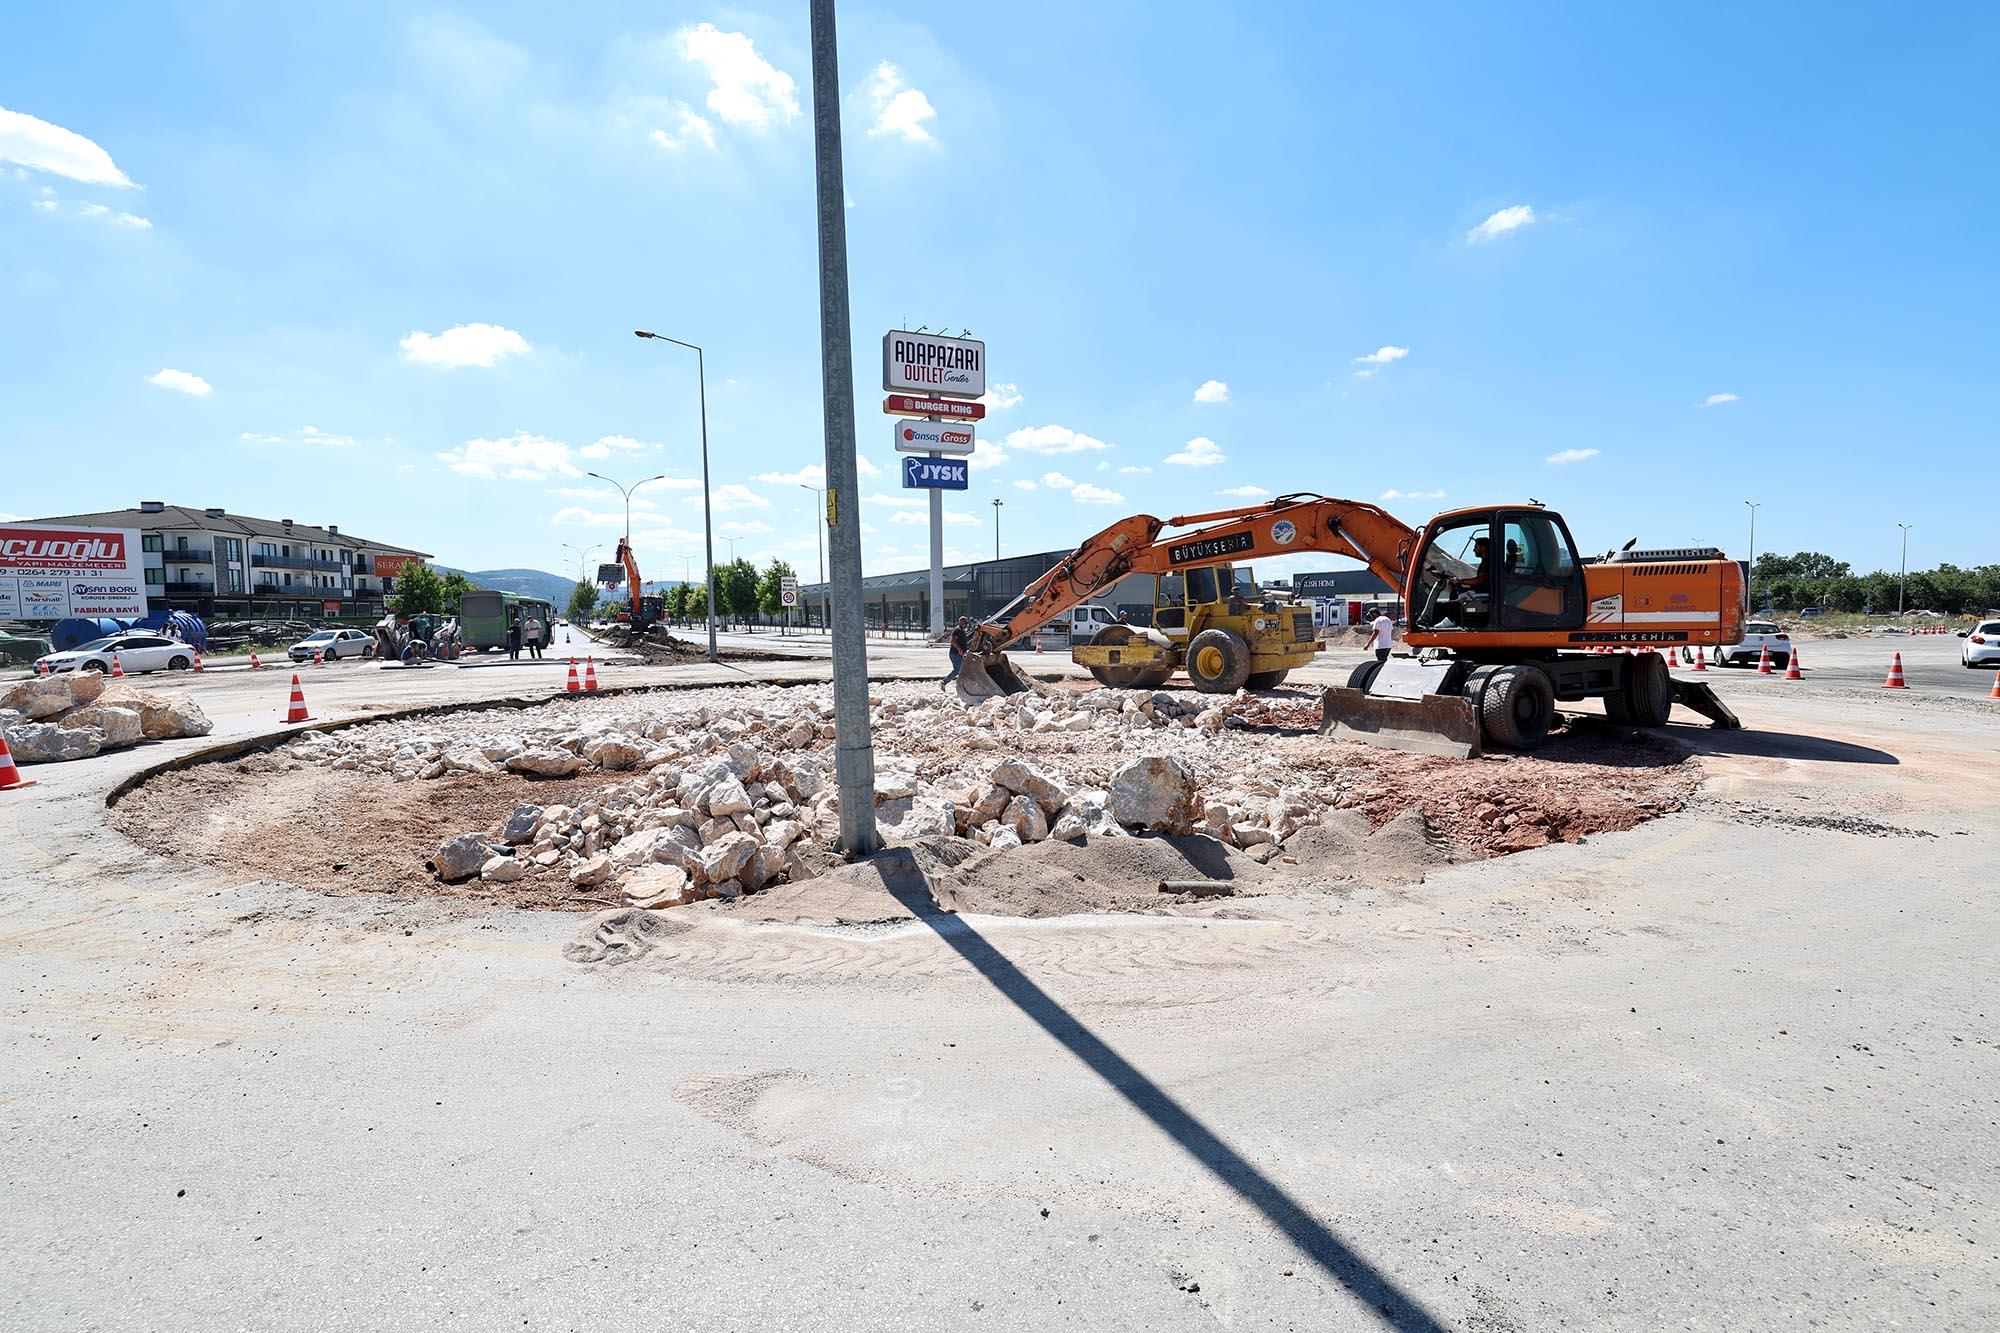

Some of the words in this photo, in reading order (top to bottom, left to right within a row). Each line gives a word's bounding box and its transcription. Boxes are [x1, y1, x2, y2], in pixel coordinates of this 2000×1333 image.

[895, 340, 979, 371] ADAPAZARI
[904, 364, 944, 384] OUTLET
[944, 370, 970, 384] Center
[915, 401, 950, 412] BURGER
[951, 405, 973, 415] KING
[943, 434, 968, 444] Gross
[920, 465, 965, 481] JYSK
[376, 561, 404, 569] SERA
[1318, 579, 1335, 588] HOME
[116, 605, 140, 613] BAYİİ
